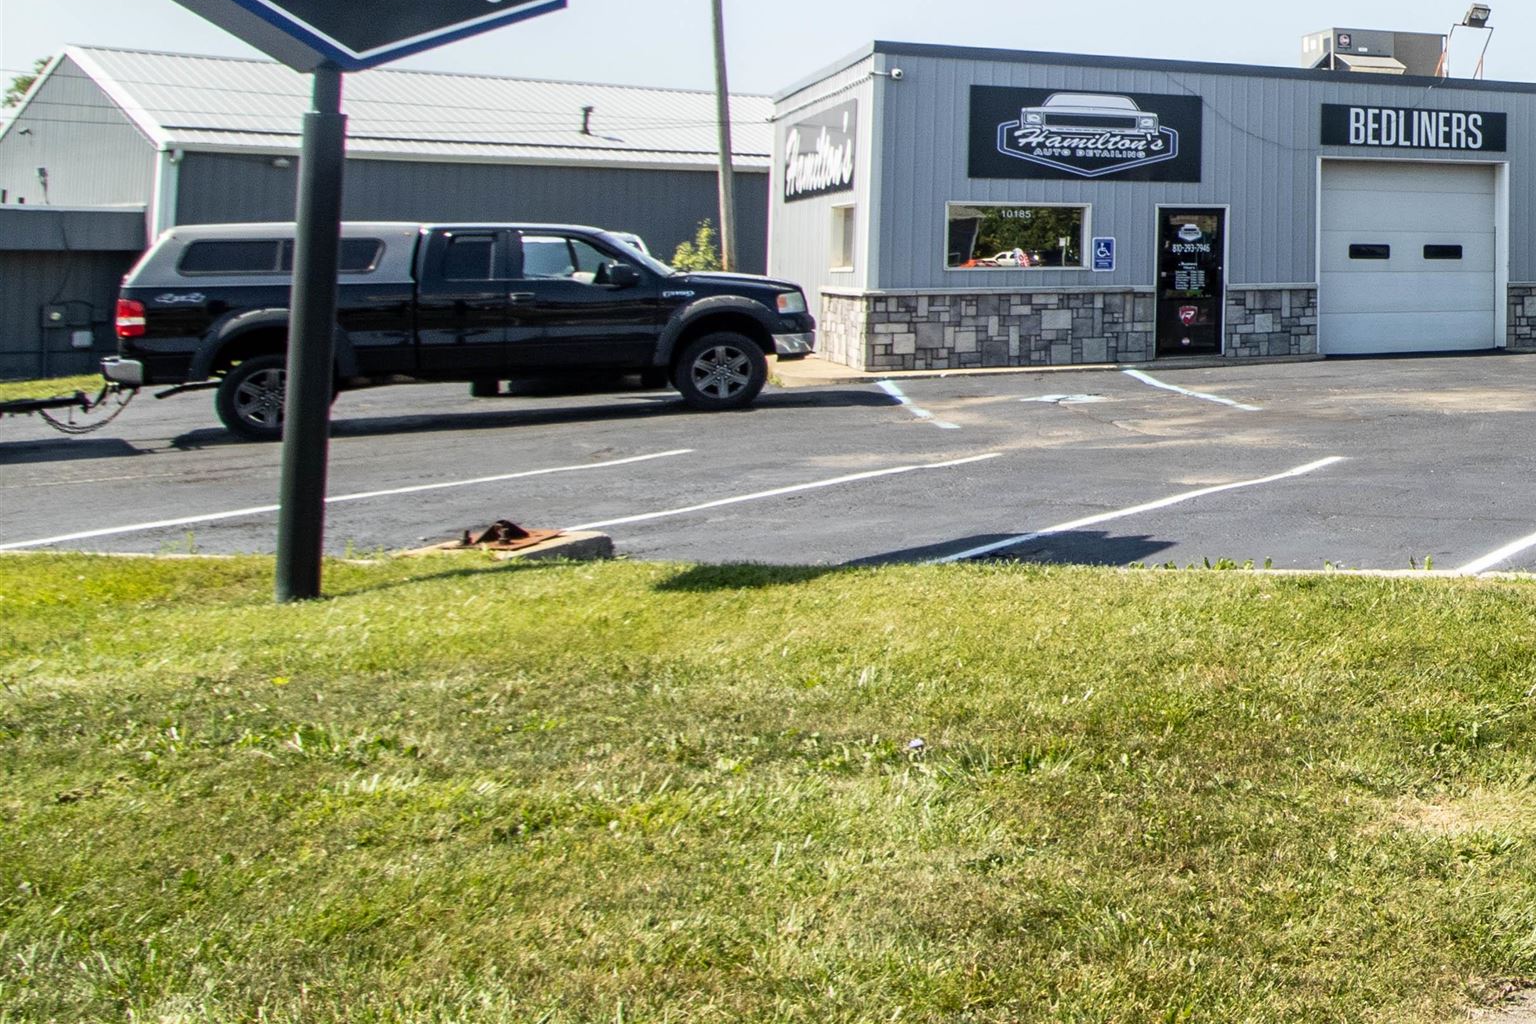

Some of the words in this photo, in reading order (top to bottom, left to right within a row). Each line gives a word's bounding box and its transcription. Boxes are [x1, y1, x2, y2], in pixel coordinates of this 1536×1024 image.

[1349, 107, 1483, 149] BEDLINERS
[1013, 128, 1165, 151] Hamilton's
[1033, 147, 1071, 157] AUTO
[1076, 148, 1146, 159] DETAILING
[1001, 209, 1032, 218] 10185
